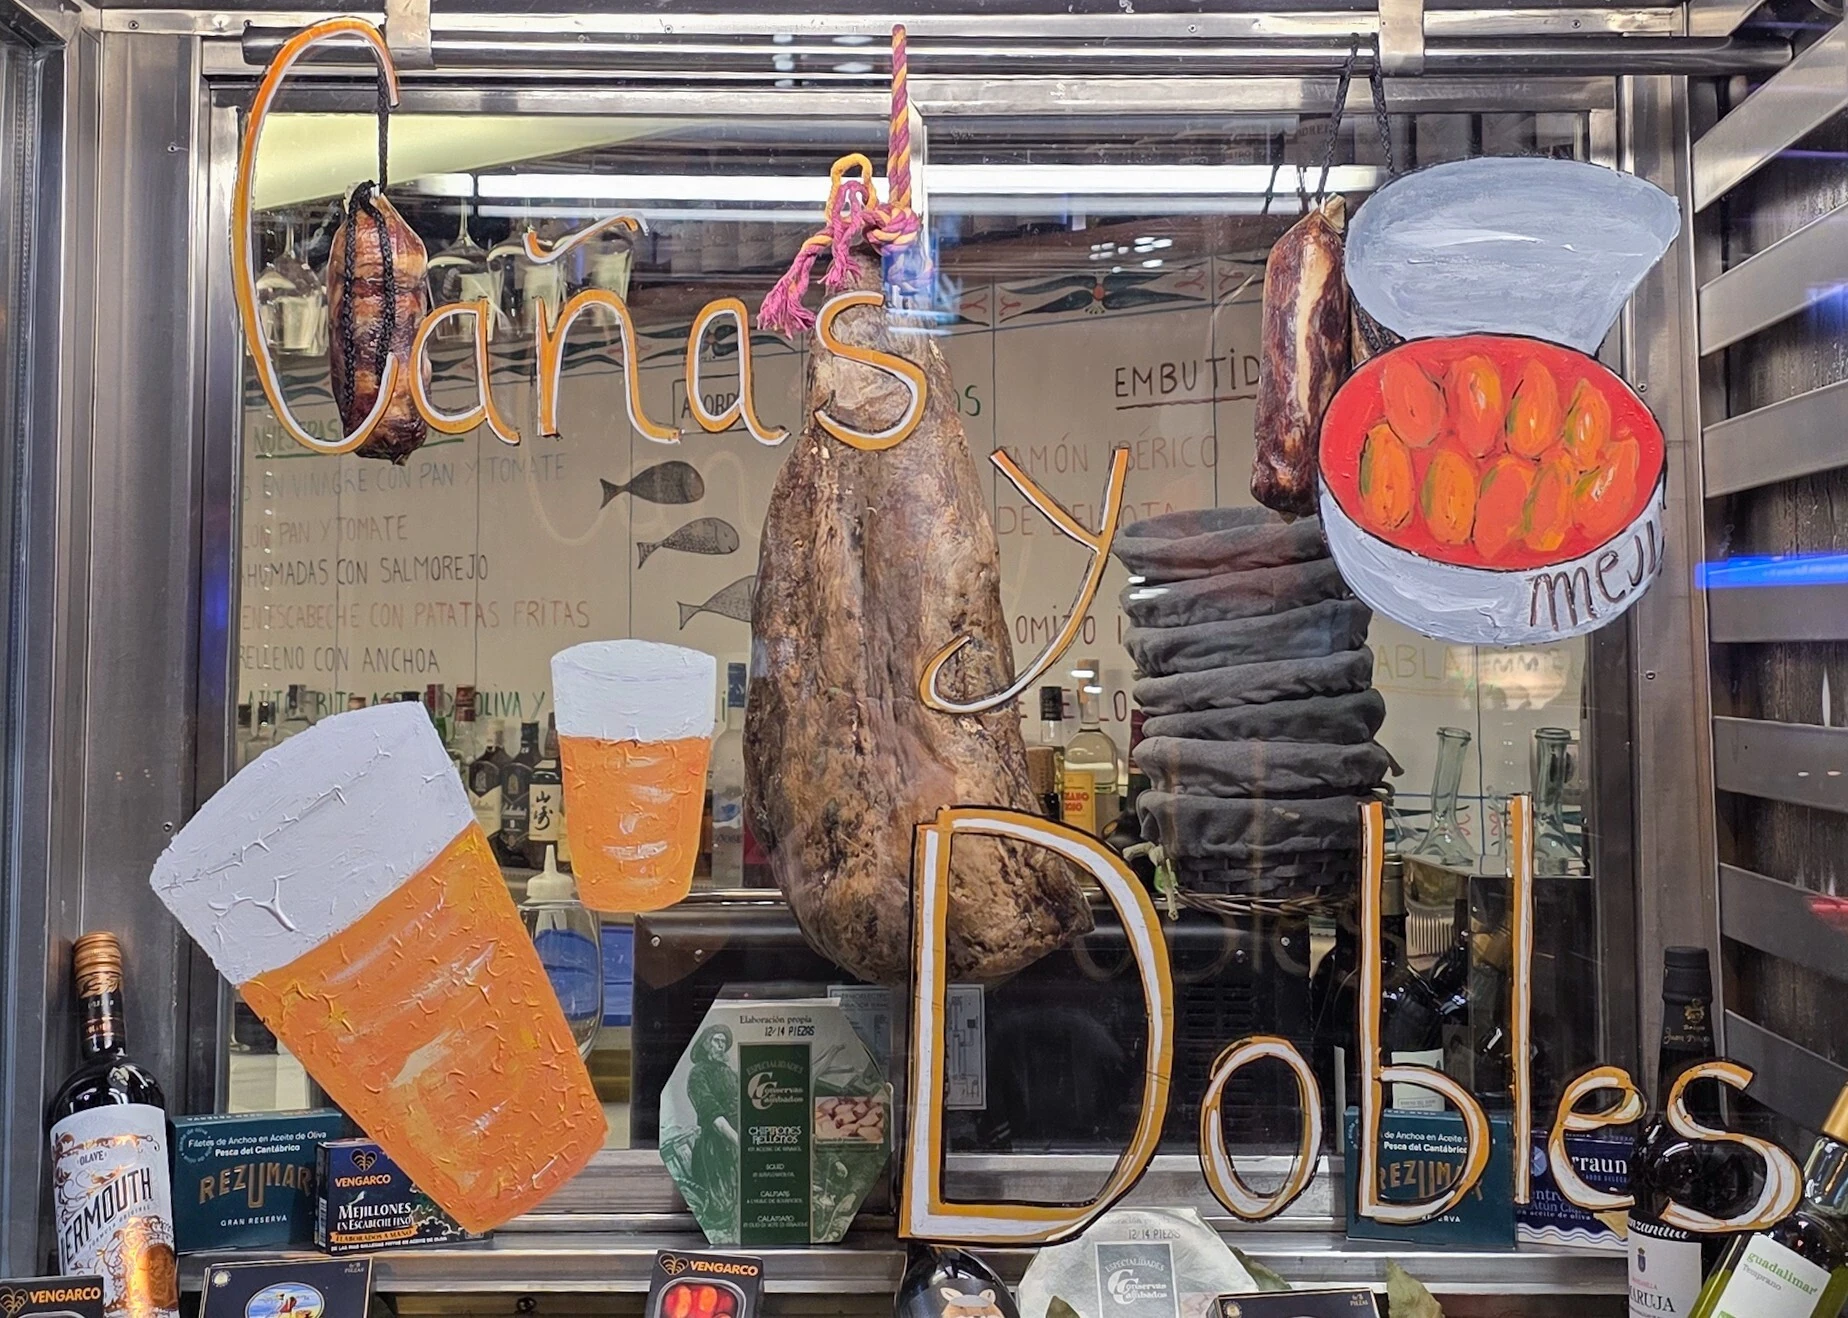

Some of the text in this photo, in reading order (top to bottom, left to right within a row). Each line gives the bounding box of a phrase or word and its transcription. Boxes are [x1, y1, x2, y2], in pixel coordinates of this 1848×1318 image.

[232, 16, 926, 456] Cañas
[1115, 349, 1260, 398] EMBUTID
[377, 466, 411, 491] CON
[420, 460, 455, 487] PAN
[465, 462, 480, 484] Y
[487, 453, 567, 482] TOMATE
[279, 520, 311, 546] PAN
[320, 519, 332, 542] Y
[336, 514, 409, 542] TOMATE
[997, 505, 1033, 536] DE
[336, 558, 369, 586] CON
[379, 553, 489, 584] SALMOREJO
[918, 447, 1128, 713] y
[242, 605, 262, 631] EN
[268, 602, 361, 630] ESCABECHE
[370, 602, 404, 631] CON
[414, 600, 501, 629] PATATAS
[239, 644, 440, 674] RELLENO CON ANCHOA
[530, 691, 546, 719] Y
[740, 1015, 813, 1025] Elaboración propia
[764, 1026, 786, 1037] 12/14
[898, 793, 1803, 1247] Dobles
[215, 1143, 301, 1157] Pesca del Cantábrico
[216, 1136, 227, 1145] de
[228, 1133, 258, 1145] Anchoa
[259, 1134, 269, 1142] en
[270, 1132, 294, 1142] Aceite
[295, 1131, 305, 1141] de
[306, 1130, 327, 1140] Oliva
[1383, 1141, 1408, 1151] Pesca
[1408, 1143, 1422, 1151] del
[1384, 1131, 1395, 1139] de
[1396, 1131, 1425, 1141] Anchoa
[1437, 1133, 1463, 1143] Aceite
[79, 1151, 104, 1166] OLAVE
[199, 1161, 312, 1209] REZUMAR
[334, 1174, 392, 1188] VENGARCO
[220, 1214, 287, 1227] GRAN RESERVA
[338, 1202, 412, 1220] MEJILLONES
[690, 1260, 759, 1276] VENGARCO
[1104, 1257, 1166, 1273] ESPECIALIDADES
[1742, 1263, 1782, 1292] Temprano
[1746, 1252, 1818, 1296] guadalimar
[29, 1286, 101, 1304] VENGARCO
